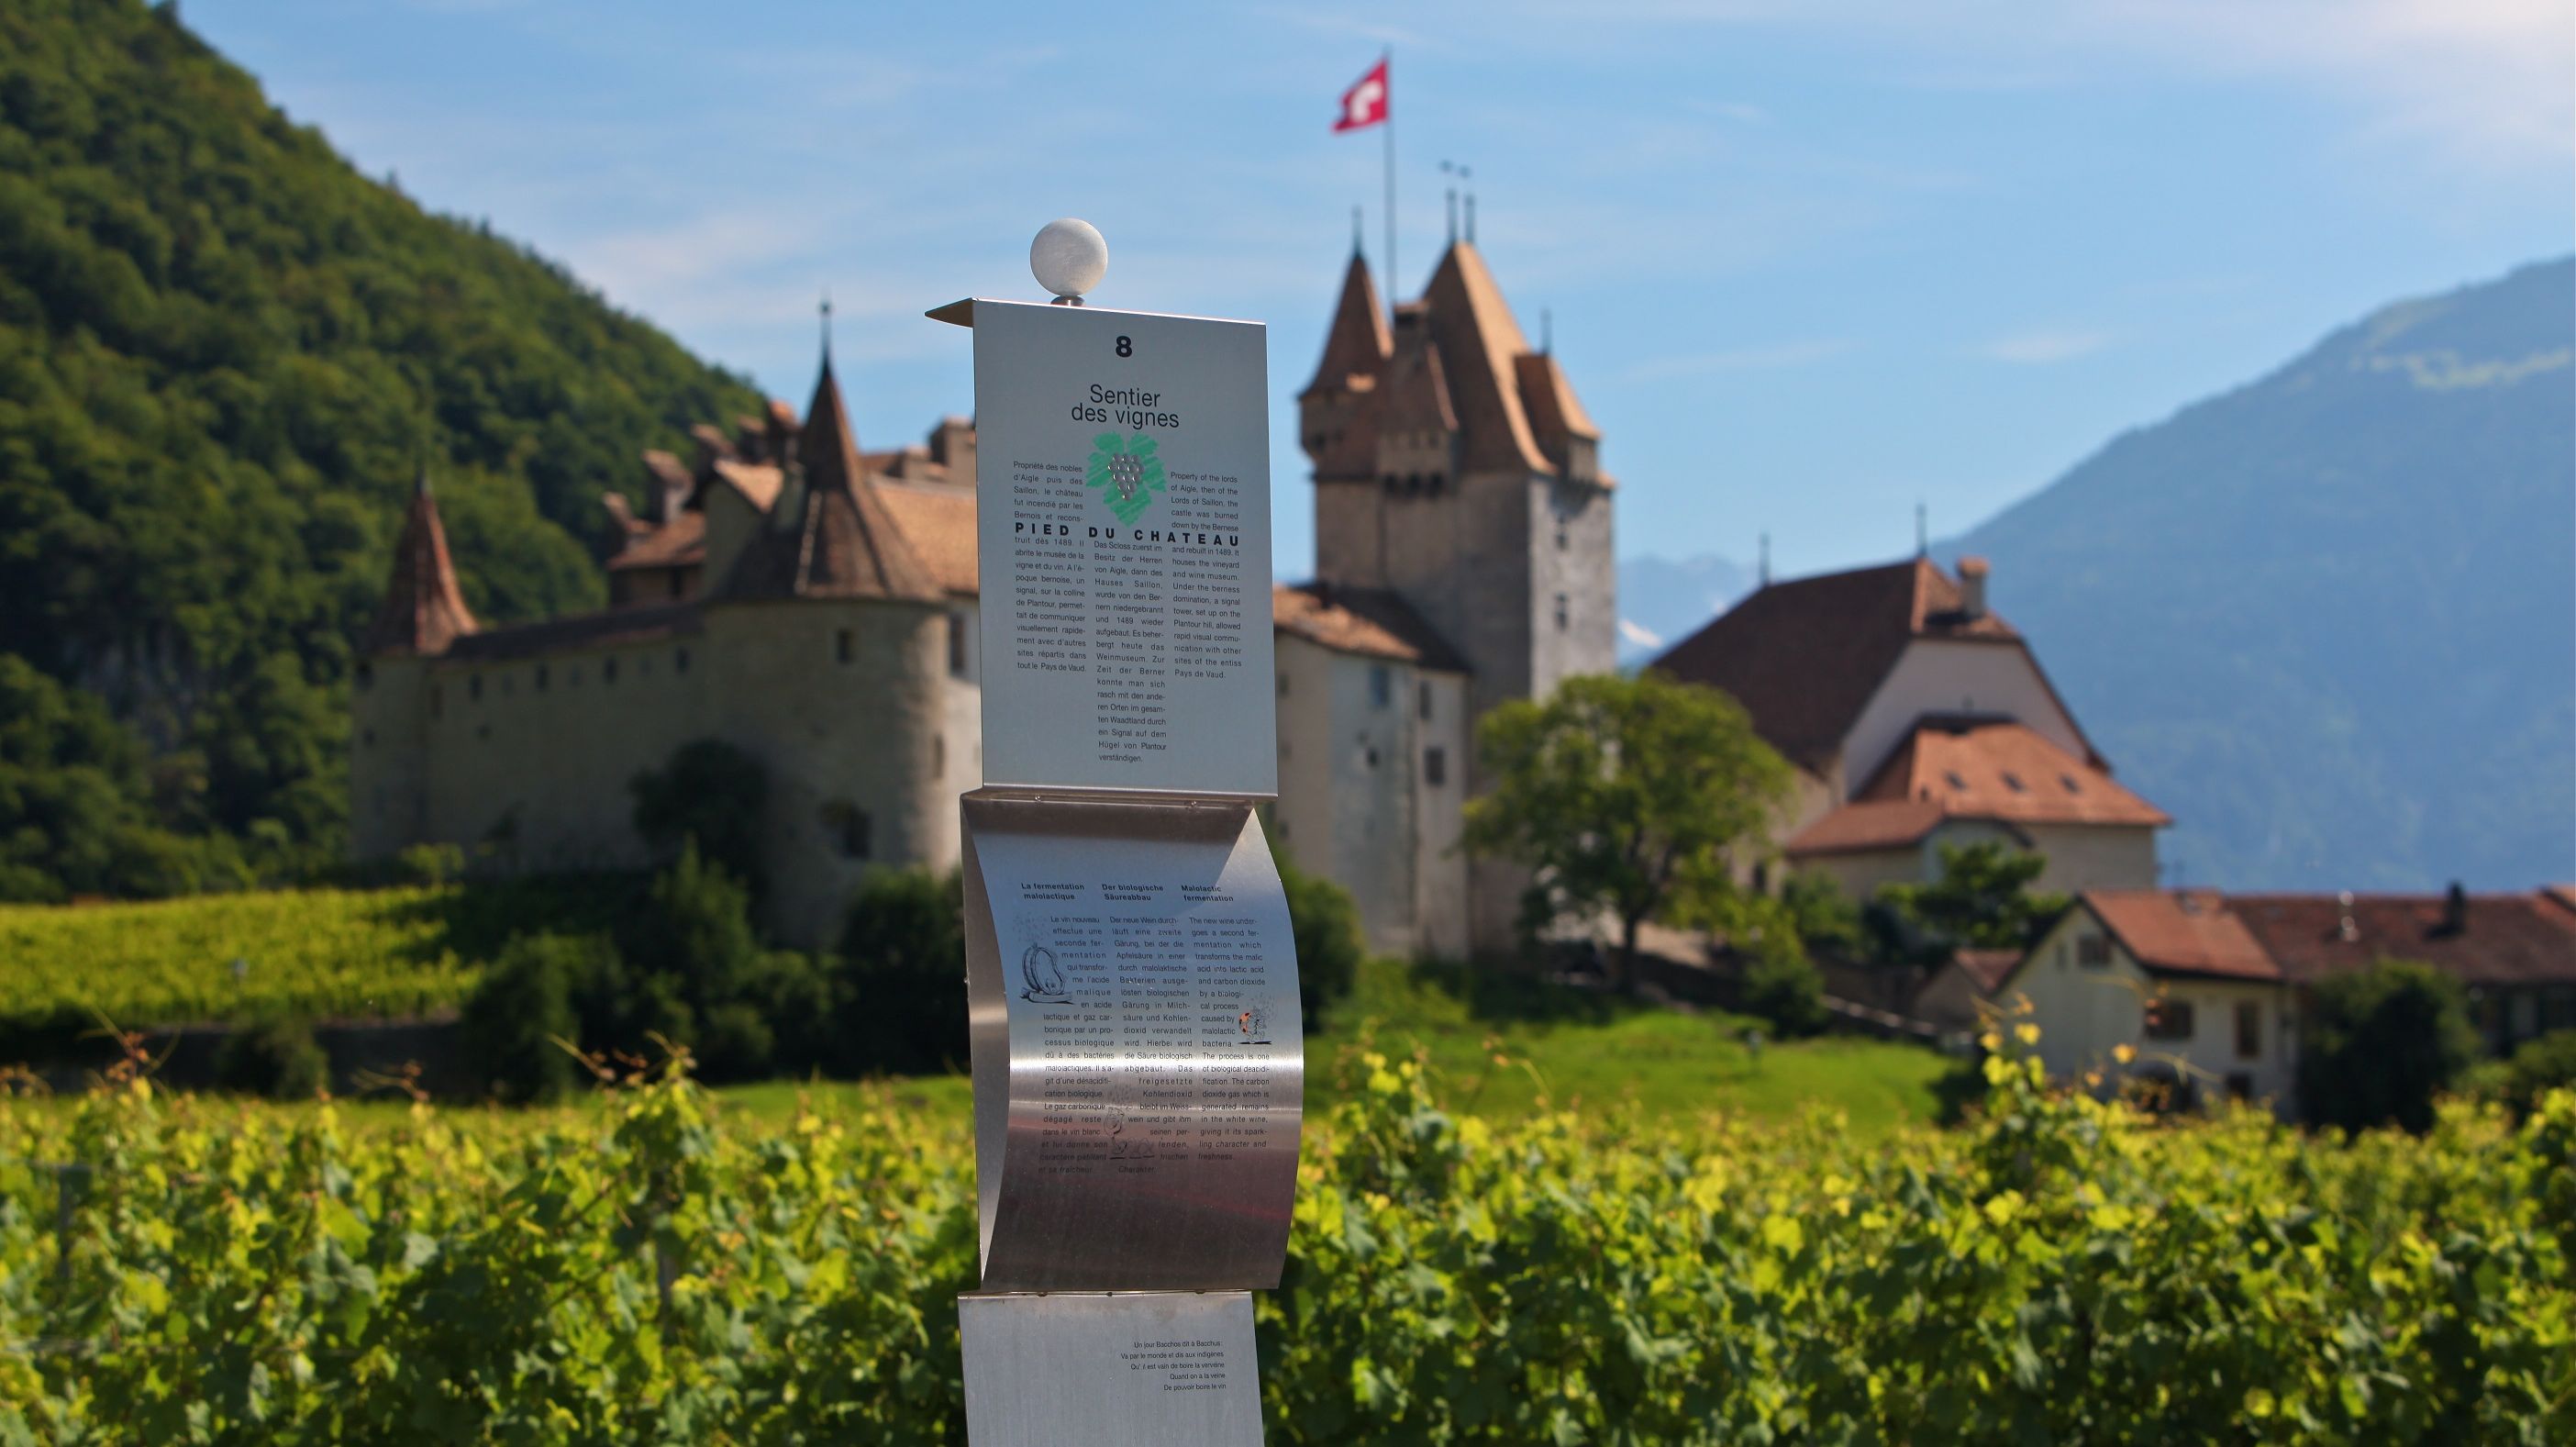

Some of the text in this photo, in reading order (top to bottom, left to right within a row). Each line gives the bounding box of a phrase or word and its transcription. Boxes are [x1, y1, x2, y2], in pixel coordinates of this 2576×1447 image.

[1116, 335, 1132, 358] 8
[1090, 384, 1160, 407] Sentier
[1071, 403, 1179, 430] des vignes
[1013, 461, 1044, 471] Propriété
[1047, 476, 1062, 485] puis
[1171, 472, 1198, 482] Property
[1014, 486, 1039, 495] Saillon,
[1055, 488, 1084, 496] château
[1016, 523, 1238, 547] PIED DU CHATEAU
[1212, 560, 1240, 570] vineyard
[1134, 580, 1163, 588] Saillon,
[1212, 584, 1240, 593] berness
[1113, 604, 1164, 615] niedergebrannt
[1040, 612, 1086, 623] communiquer
[1016, 624, 1086, 635] visuellement rapide-
[1174, 632, 1191, 641] rapid
[1097, 640, 1114, 650] bergt
[1038, 650, 1065, 660] répartis
[1175, 669, 1192, 679] Pays
[1118, 884, 1164, 893] biologische
[1024, 893, 1075, 901] malolactique
[1077, 988, 1111, 997] malique
[1146, 989, 1190, 998] biologischen
[1043, 1013, 1070, 1022] lactique
[1075, 1039, 1114, 1048] biologique
